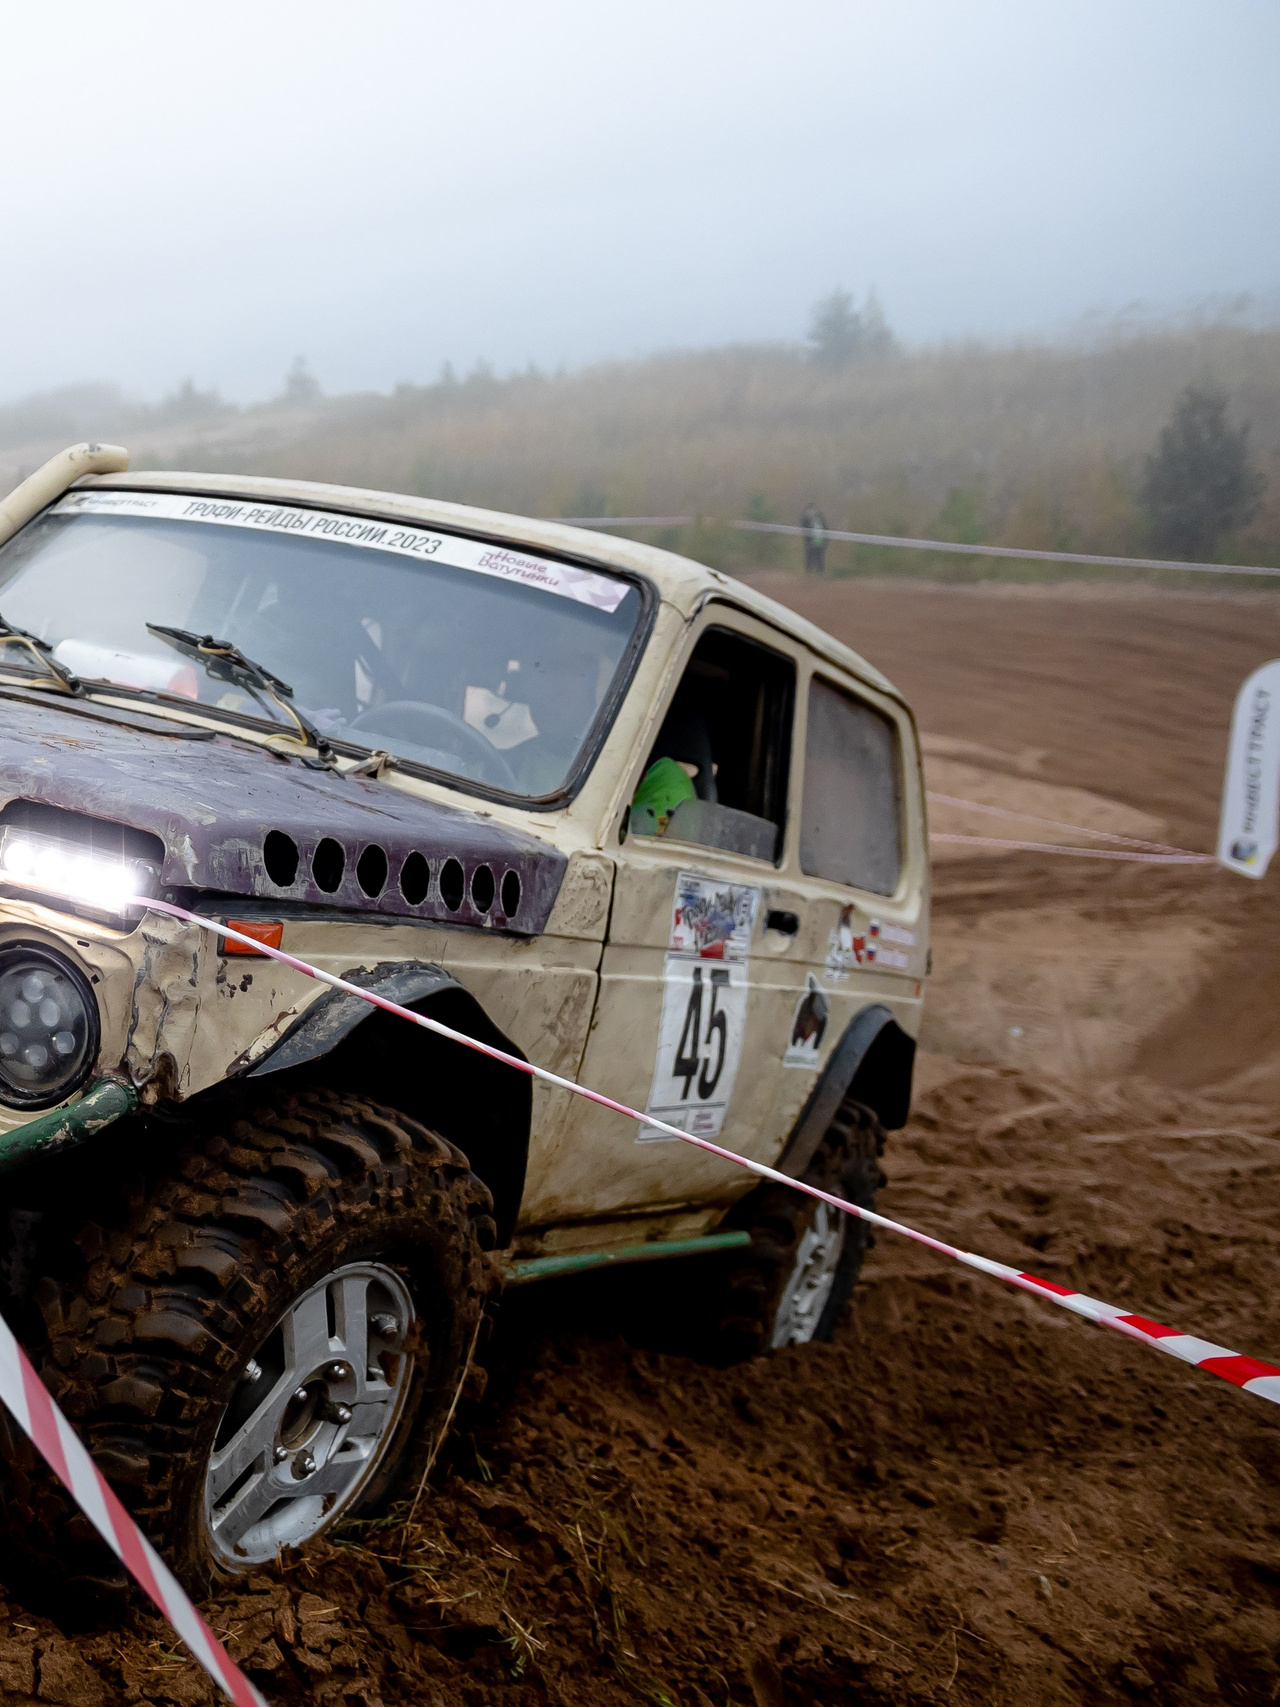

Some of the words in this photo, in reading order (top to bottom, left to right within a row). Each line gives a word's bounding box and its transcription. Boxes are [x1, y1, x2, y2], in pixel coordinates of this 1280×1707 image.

[181, 501, 313, 530] ТРОФИ-РЕЙДЫ
[478, 556, 560, 587] Ватутинки
[485, 550, 547, 573] Новые
[673, 966, 730, 1100] 45
